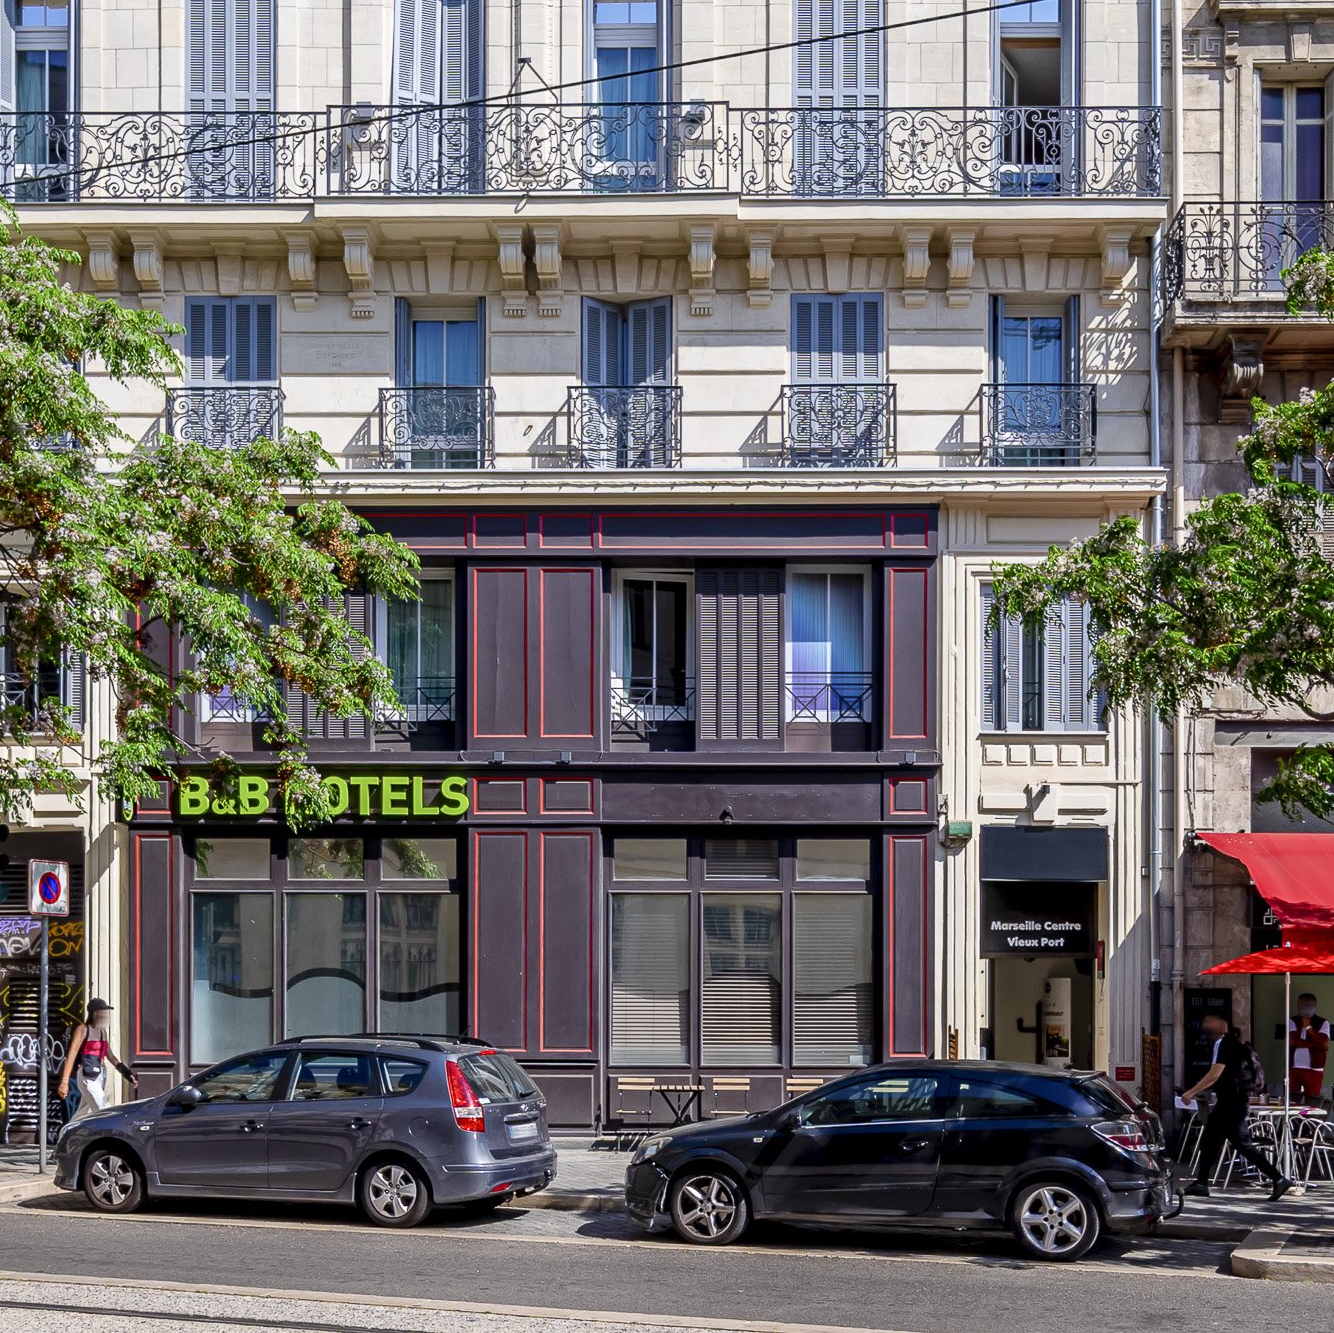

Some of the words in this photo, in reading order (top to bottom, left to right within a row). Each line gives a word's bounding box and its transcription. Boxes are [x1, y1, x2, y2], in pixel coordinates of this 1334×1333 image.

[180, 775, 270, 815] B&B
[990, 920, 1042, 931] Marseille
[1043, 921, 1082, 931] Centre
[1007, 936, 1039, 947] Vieux
[1040, 937, 1065, 947] Port
